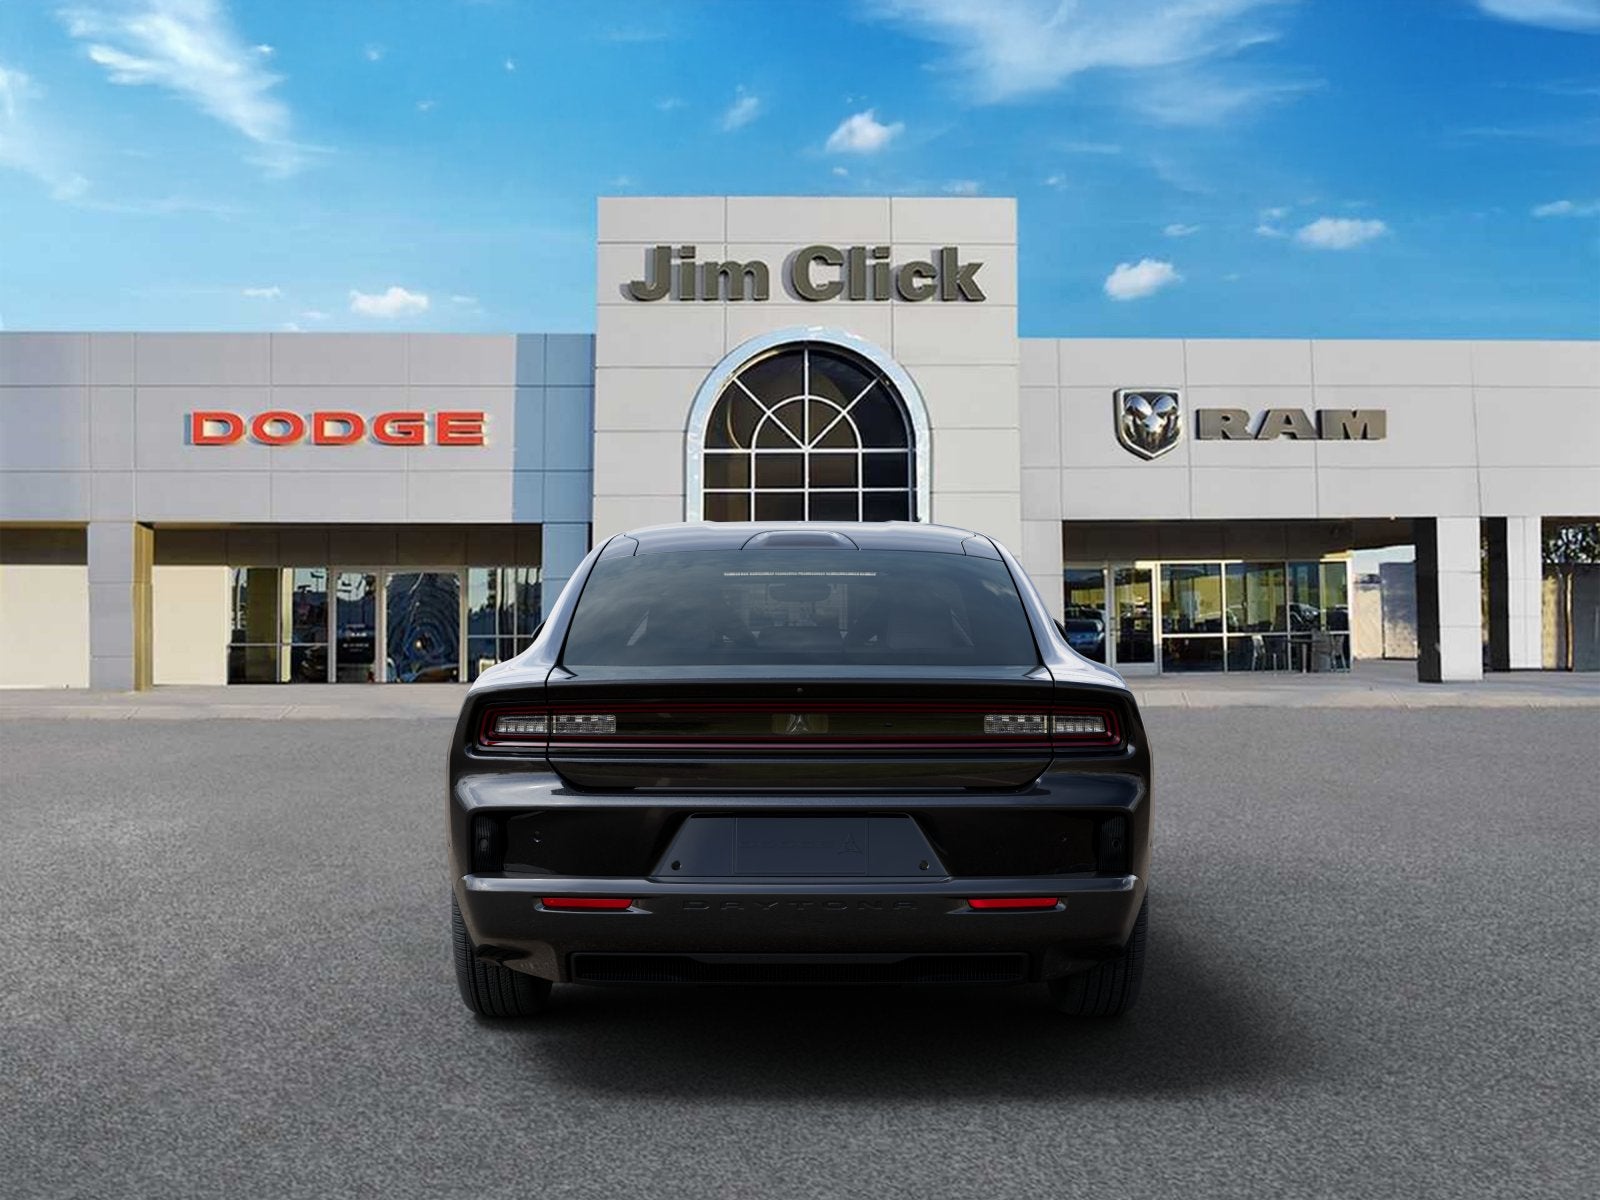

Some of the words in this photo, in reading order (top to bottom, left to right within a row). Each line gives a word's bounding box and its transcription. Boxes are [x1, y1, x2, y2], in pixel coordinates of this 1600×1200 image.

[628, 245, 770, 301] Jim
[790, 245, 986, 302] Click
[190, 410, 486, 446] DODGE
[1196, 408, 1387, 441] RAM
[682, 899, 920, 911] DAYTONA
